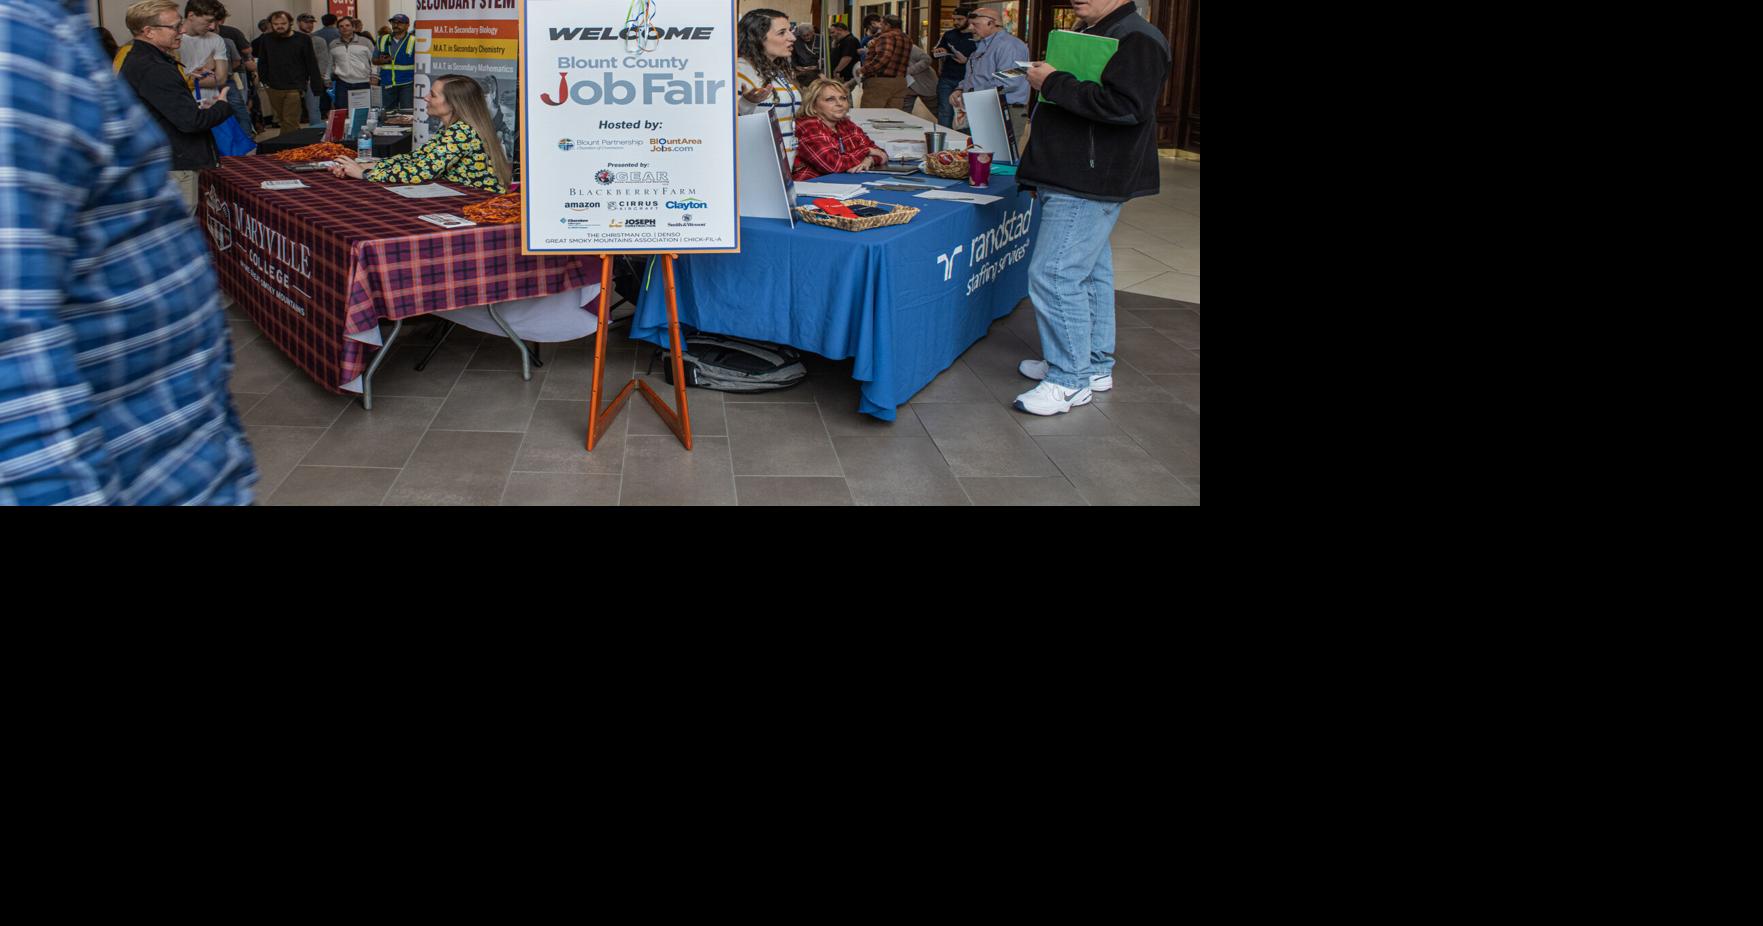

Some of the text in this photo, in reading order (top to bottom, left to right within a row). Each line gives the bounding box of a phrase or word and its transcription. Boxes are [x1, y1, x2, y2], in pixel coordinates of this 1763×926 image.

[480, 0, 515, 9] STEM
[449, 26, 454, 34] in
[454, 26, 479, 35] Secondary
[480, 27, 498, 36] Biology
[549, 26, 714, 41] WELCOME
[454, 45, 478, 54] Secondary
[479, 46, 506, 55] Chemistry
[453, 63, 477, 71] Secondary
[478, 64, 514, 73] Mathematics
[558, 56, 688, 71] Blount County
[540, 72, 725, 106] Job Fair
[599, 120, 663, 131] Hosted by:
[601, 139, 644, 148] Partnership
[615, 171, 669, 181] GEAR
[665, 201, 708, 211] Clayton
[969, 197, 1034, 268] randstad
[232, 202, 312, 280] MARYVILLE
[248, 248, 290, 289] COLLEGE
[965, 261, 997, 297] staffing
